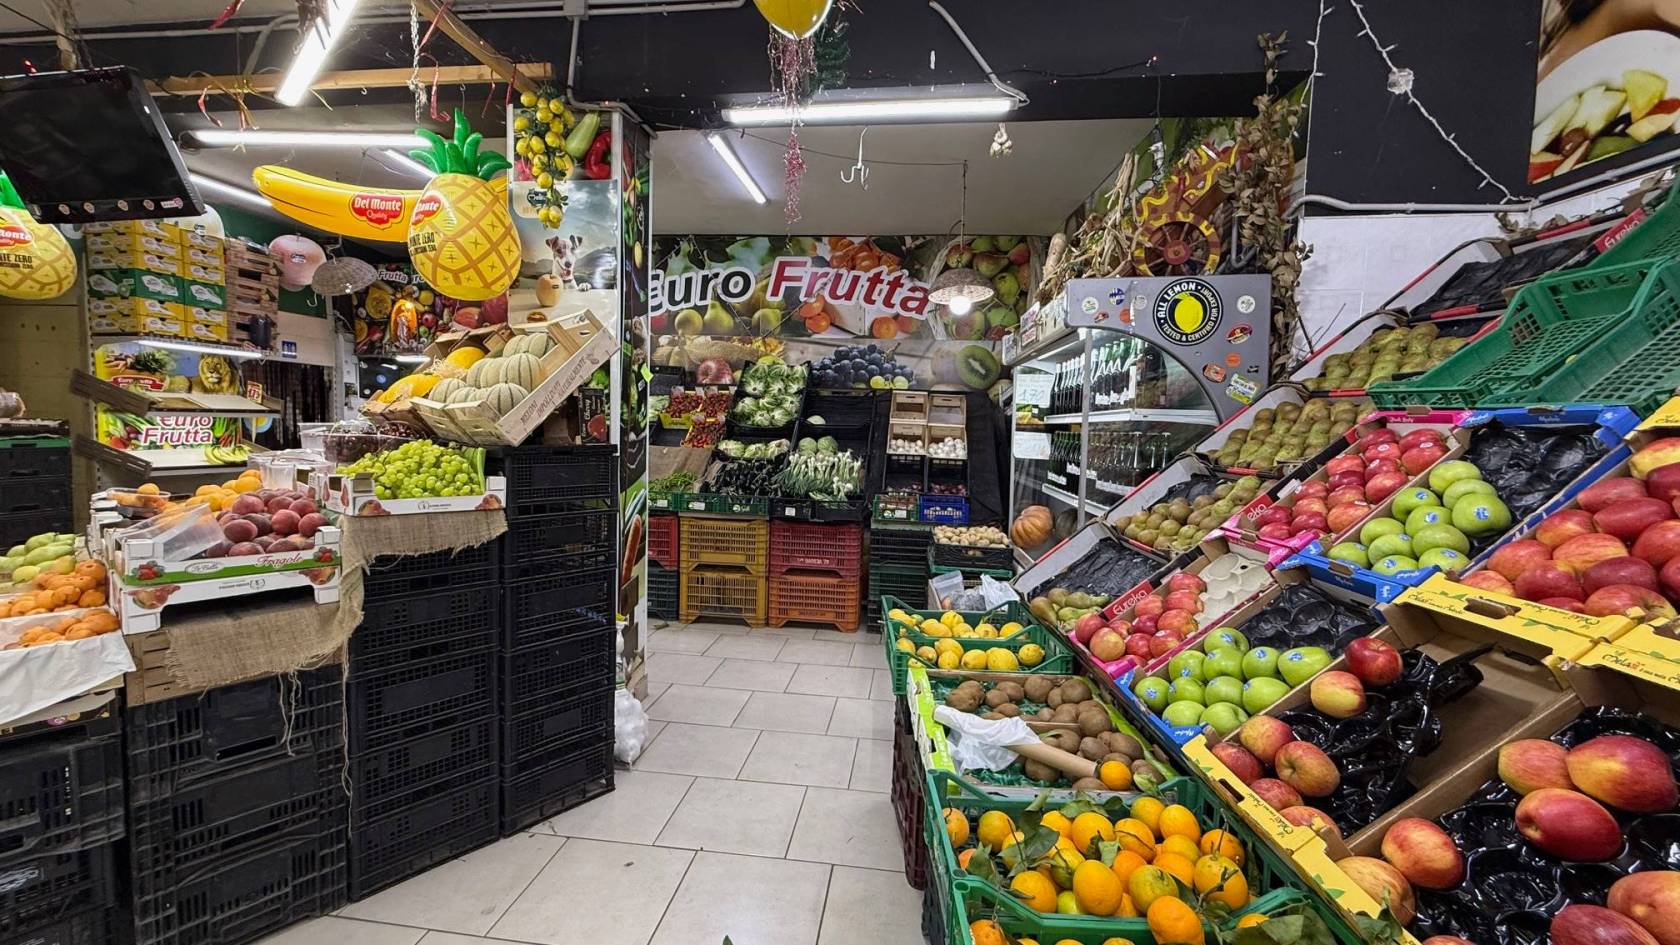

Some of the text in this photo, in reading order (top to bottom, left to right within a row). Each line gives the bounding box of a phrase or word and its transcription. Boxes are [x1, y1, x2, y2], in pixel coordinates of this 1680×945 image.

[354, 197, 401, 211] Del Monte
[378, 271, 408, 282] Frutta
[769, 260, 929, 315] Frutta
[1157, 281, 1196, 318] ALL LEMON
[1200, 287, 1218, 308] EXPORT
[1210, 308, 1219, 321] FOR
[1162, 323, 1181, 340] TESTED
[1187, 321, 1215, 341] CERTIFIED
[144, 427, 212, 445] Frutta
[1247, 503, 1267, 521] eka
[255, 553, 304, 569] Fragole
[1113, 590, 1148, 615] Eureka
